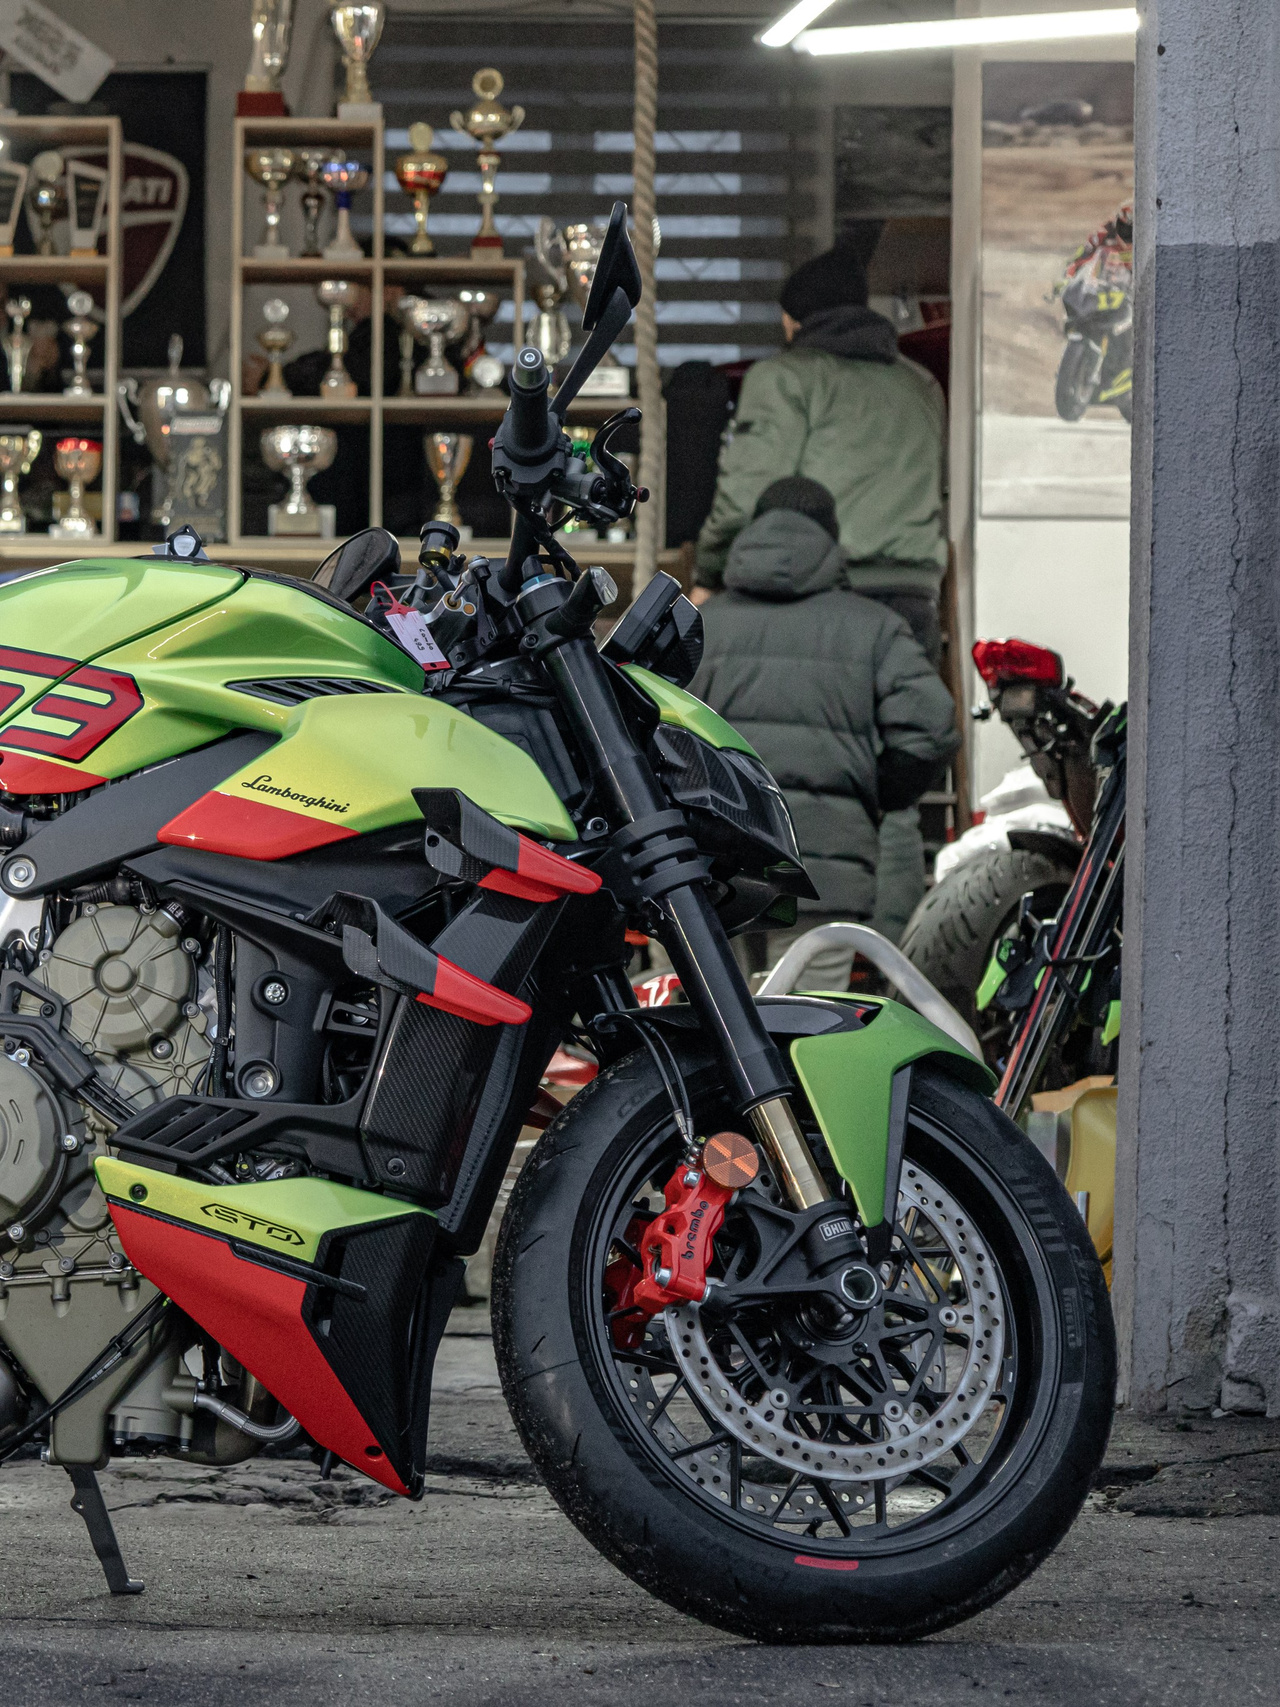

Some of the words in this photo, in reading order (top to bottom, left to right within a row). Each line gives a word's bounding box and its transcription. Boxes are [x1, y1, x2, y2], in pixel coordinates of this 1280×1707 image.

[1097, 291, 1125, 311] 17
[241, 774, 351, 813] Lamborghini
[214, 1207, 293, 1242] STO
[681, 1200, 709, 1260] brembo
